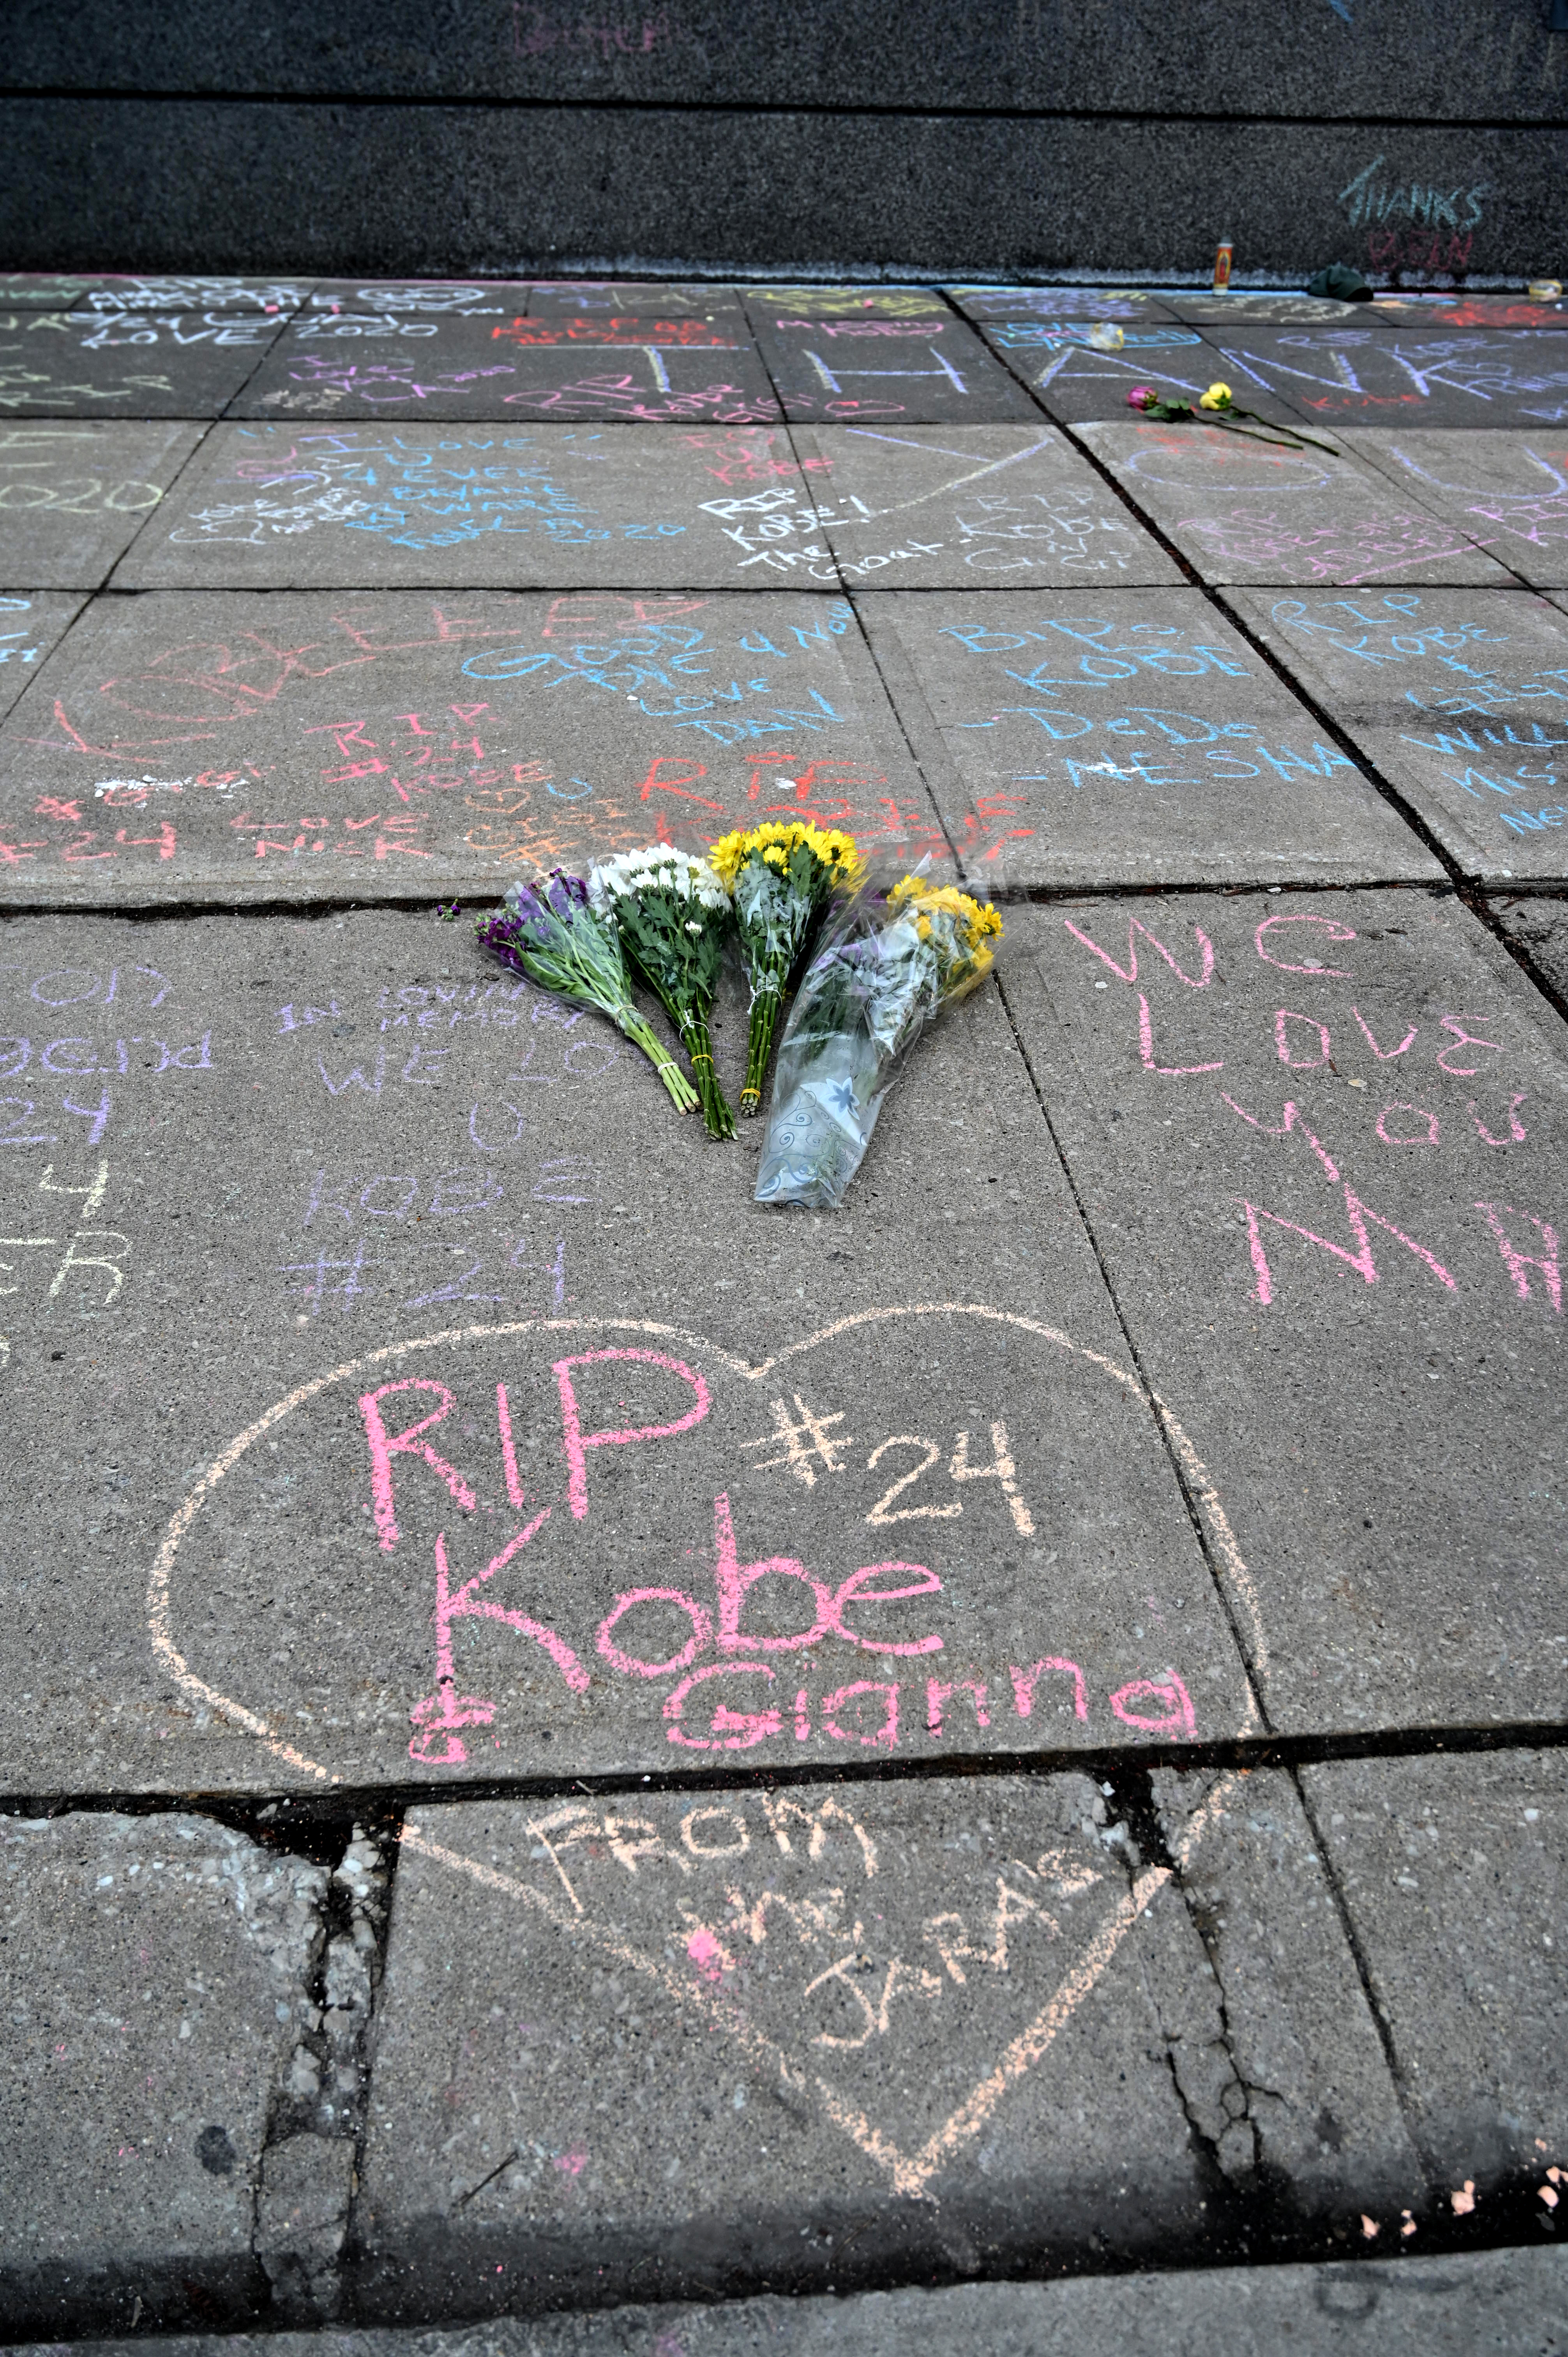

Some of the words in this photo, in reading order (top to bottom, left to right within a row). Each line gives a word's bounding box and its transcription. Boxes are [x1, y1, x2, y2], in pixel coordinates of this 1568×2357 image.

[1336, 154, 1492, 232] THANKS
[80, 329, 270, 350] LOVE
[295, 325, 440, 339] 2020
[503, 374, 649, 413] RIP
[516, 344, 1494, 401] THANK
[392, 436, 536, 450] LOVE
[340, 467, 377, 486] 4
[401, 466, 553, 484] EVER
[965, 486, 1094, 512] RIP
[697, 487, 798, 520] RIP
[1271, 593, 1422, 636] RIP
[462, 624, 704, 680] GOOD
[1005, 645, 1254, 697] KOBE
[1328, 623, 1509, 666] KOBE
[640, 677, 772, 718] LOVE
[675, 688, 846, 746] DAN
[320, 736, 486, 784] #24
[391, 760, 552, 802] KOBE
[229, 813, 429, 835] LOVE
[1136, 991, 1507, 1079] LOVE
[316, 1043, 449, 1097] WE
[468, 1098, 525, 1153] U
[301, 1154, 606, 1230] KOBE
[277, 1228, 569, 1317] #24
[358, 1346, 713, 1554] RIP
[739, 1391, 1036, 1539] #24
[431, 1491, 945, 1696] Kobe
[662, 1654, 1199, 1751] Gianna
[526, 1791, 881, 1914] FROM
